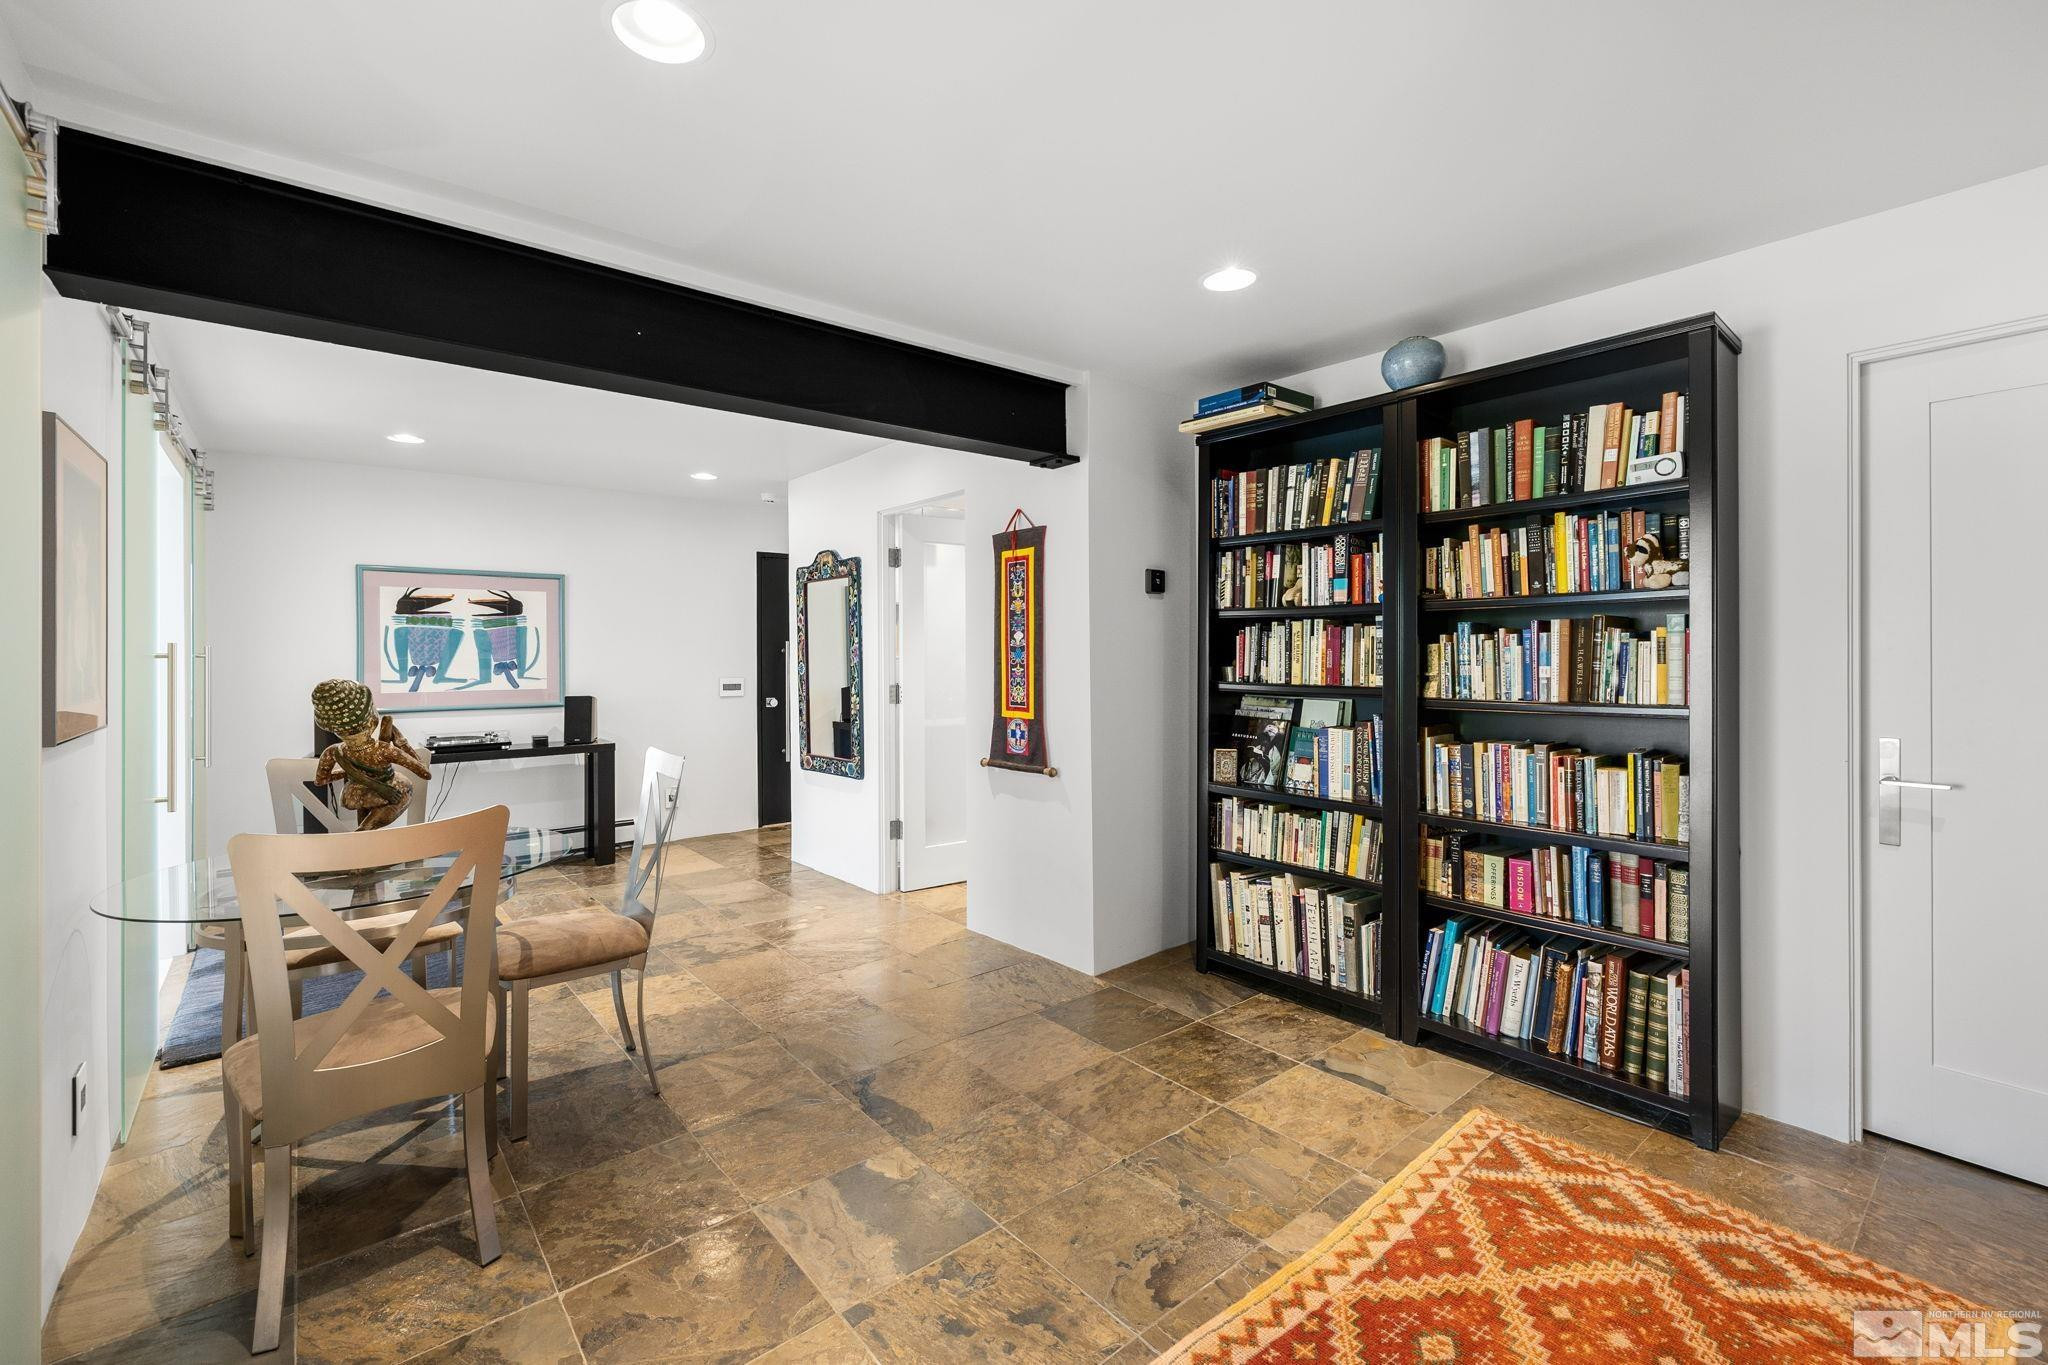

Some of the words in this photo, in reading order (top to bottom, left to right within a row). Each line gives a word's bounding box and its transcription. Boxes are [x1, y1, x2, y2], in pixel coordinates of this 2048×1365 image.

[1309, 948, 1321, 974] ART
[1514, 963, 1523, 978] The
[1509, 979, 1521, 1007] Wyeths
[1606, 987, 1618, 1026] WORLD
[1603, 1027, 1617, 1058] ATLAS
